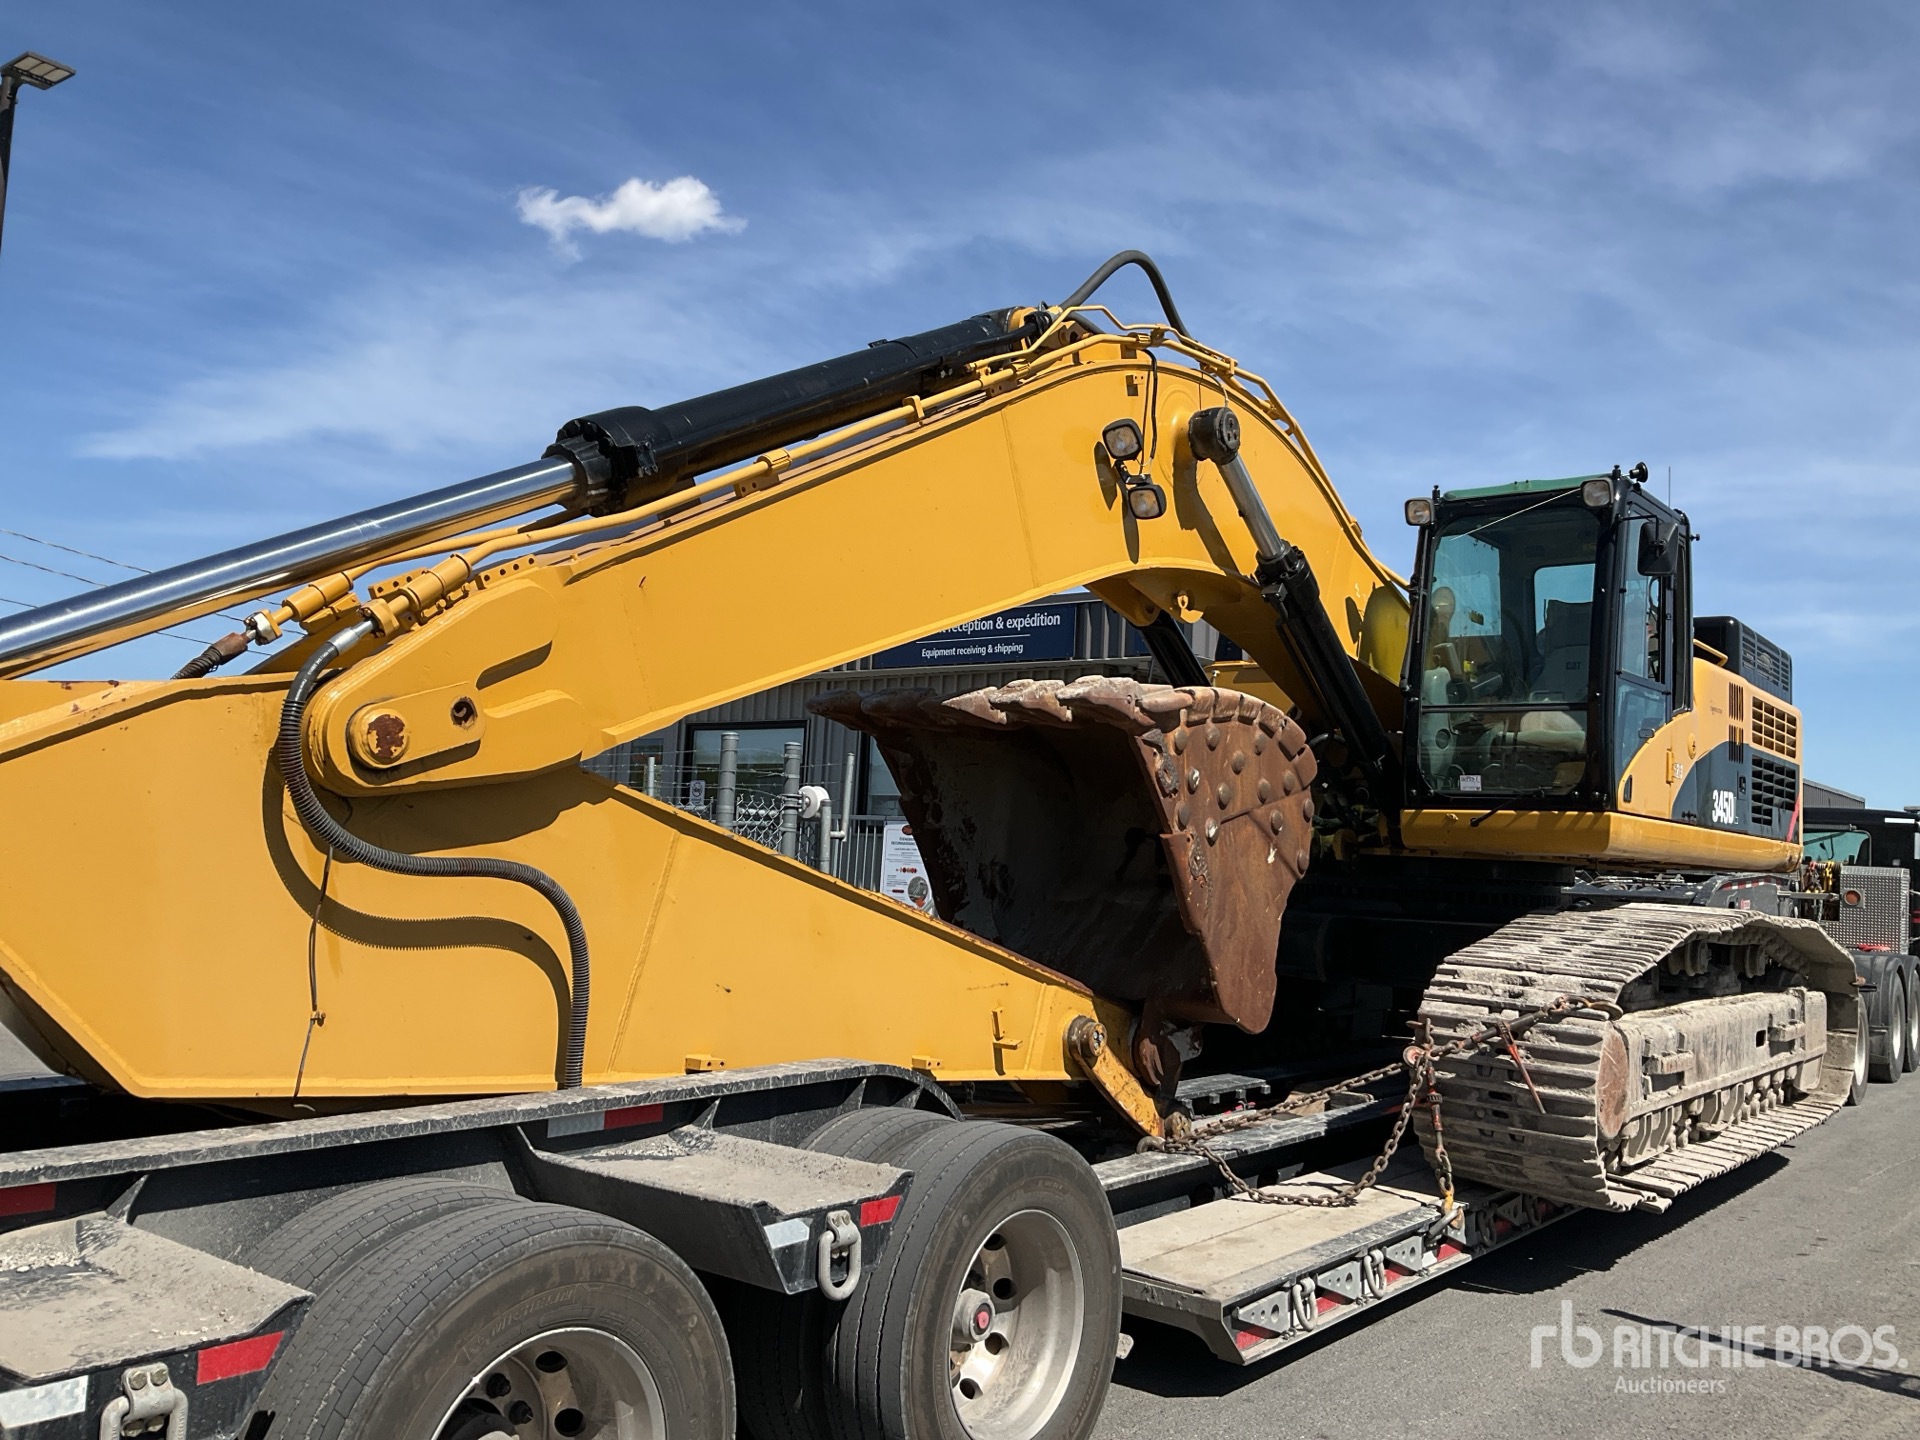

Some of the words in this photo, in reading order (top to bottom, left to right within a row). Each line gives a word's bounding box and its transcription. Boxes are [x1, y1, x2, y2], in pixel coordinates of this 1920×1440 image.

[995, 616, 1004, 630] &
[1006, 612, 1061, 631] expédition
[921, 647, 956, 658] Equipment
[956, 645, 986, 656] receiving
[987, 644, 993, 654] &
[994, 643, 1024, 654] shipping
[1712, 789, 1735, 825] 345D
